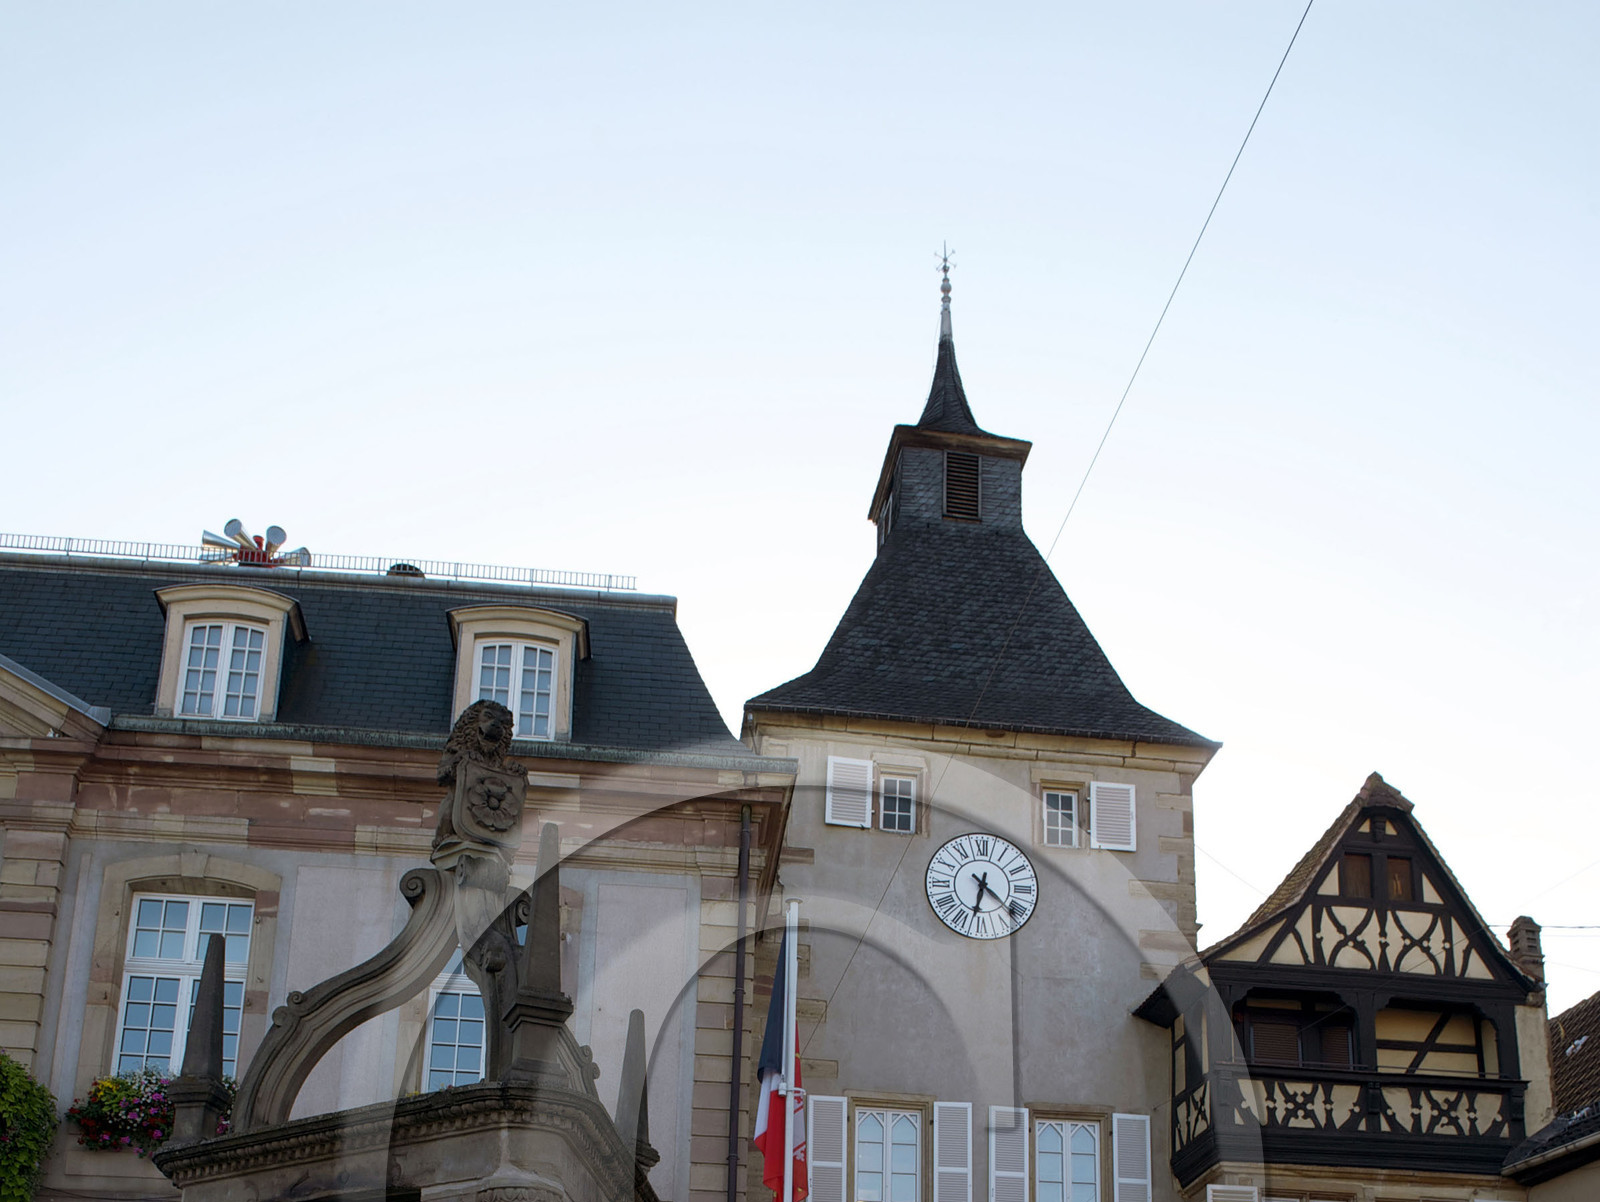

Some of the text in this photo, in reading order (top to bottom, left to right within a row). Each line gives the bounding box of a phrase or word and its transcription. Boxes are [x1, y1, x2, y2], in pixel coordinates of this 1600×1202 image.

[952, 842, 969, 861] XI
[975, 839, 989, 857] XII
[998, 847, 1009, 862] I
[937, 857, 956, 872] X
[1008, 864, 1027, 876] II
[931, 877, 950, 888] IX
[1013, 884, 1032, 894] III
[936, 894, 958, 915] VIII
[951, 908, 969, 929] VII
[976, 916, 988, 934] VI
[998, 913, 1010, 931] V
